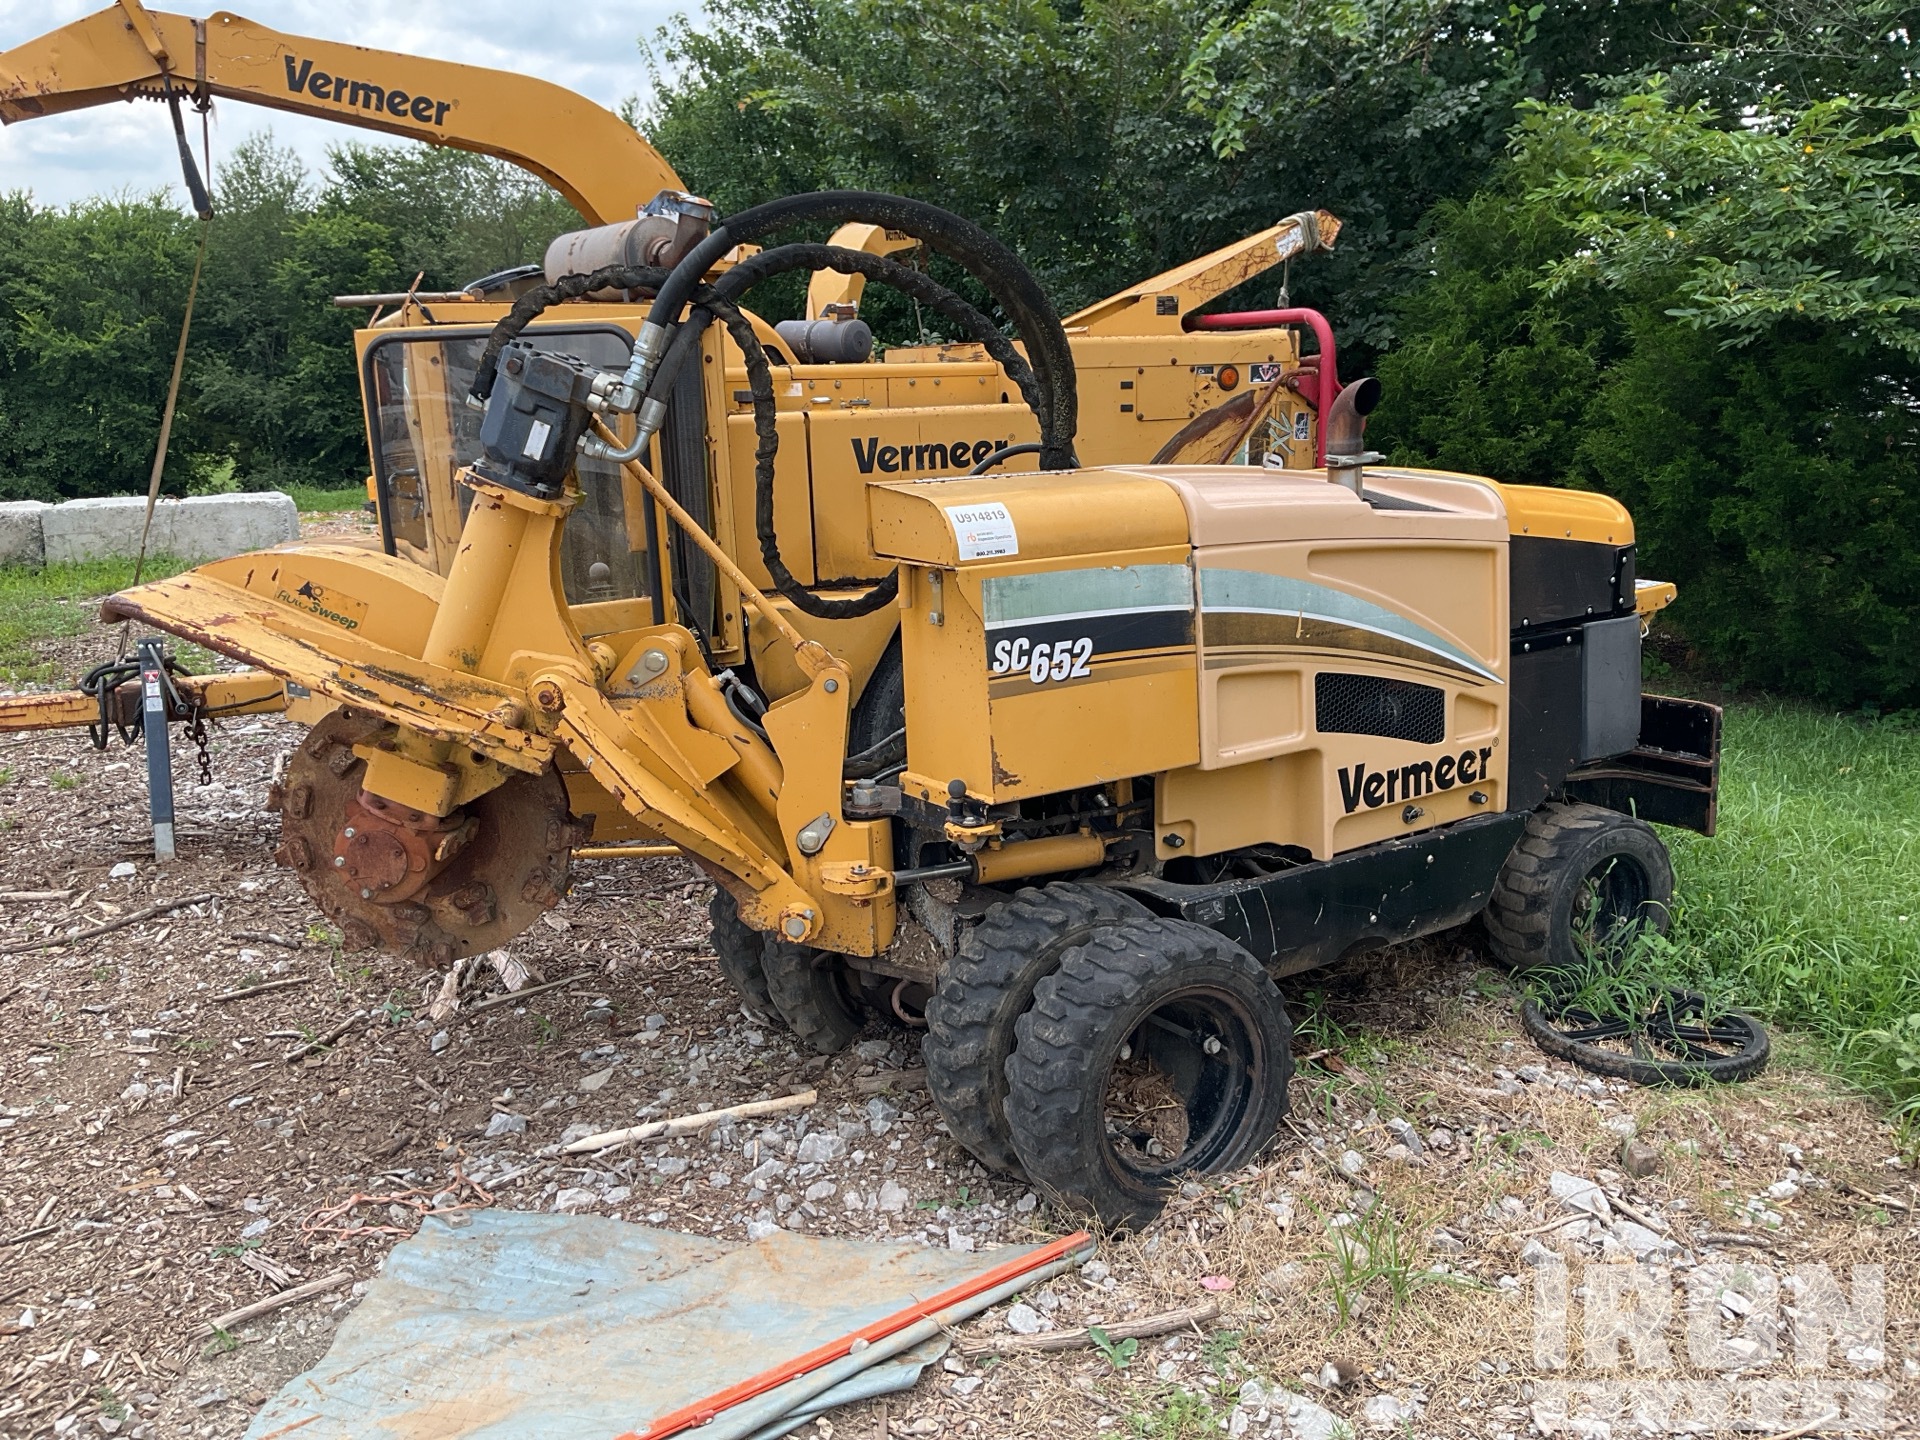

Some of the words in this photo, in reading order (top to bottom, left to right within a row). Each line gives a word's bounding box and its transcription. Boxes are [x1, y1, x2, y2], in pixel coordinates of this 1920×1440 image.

[284, 54, 451, 126] Vermeer
[955, 510, 1006, 524] U914819
[1337, 746, 1493, 814] Vermeer
